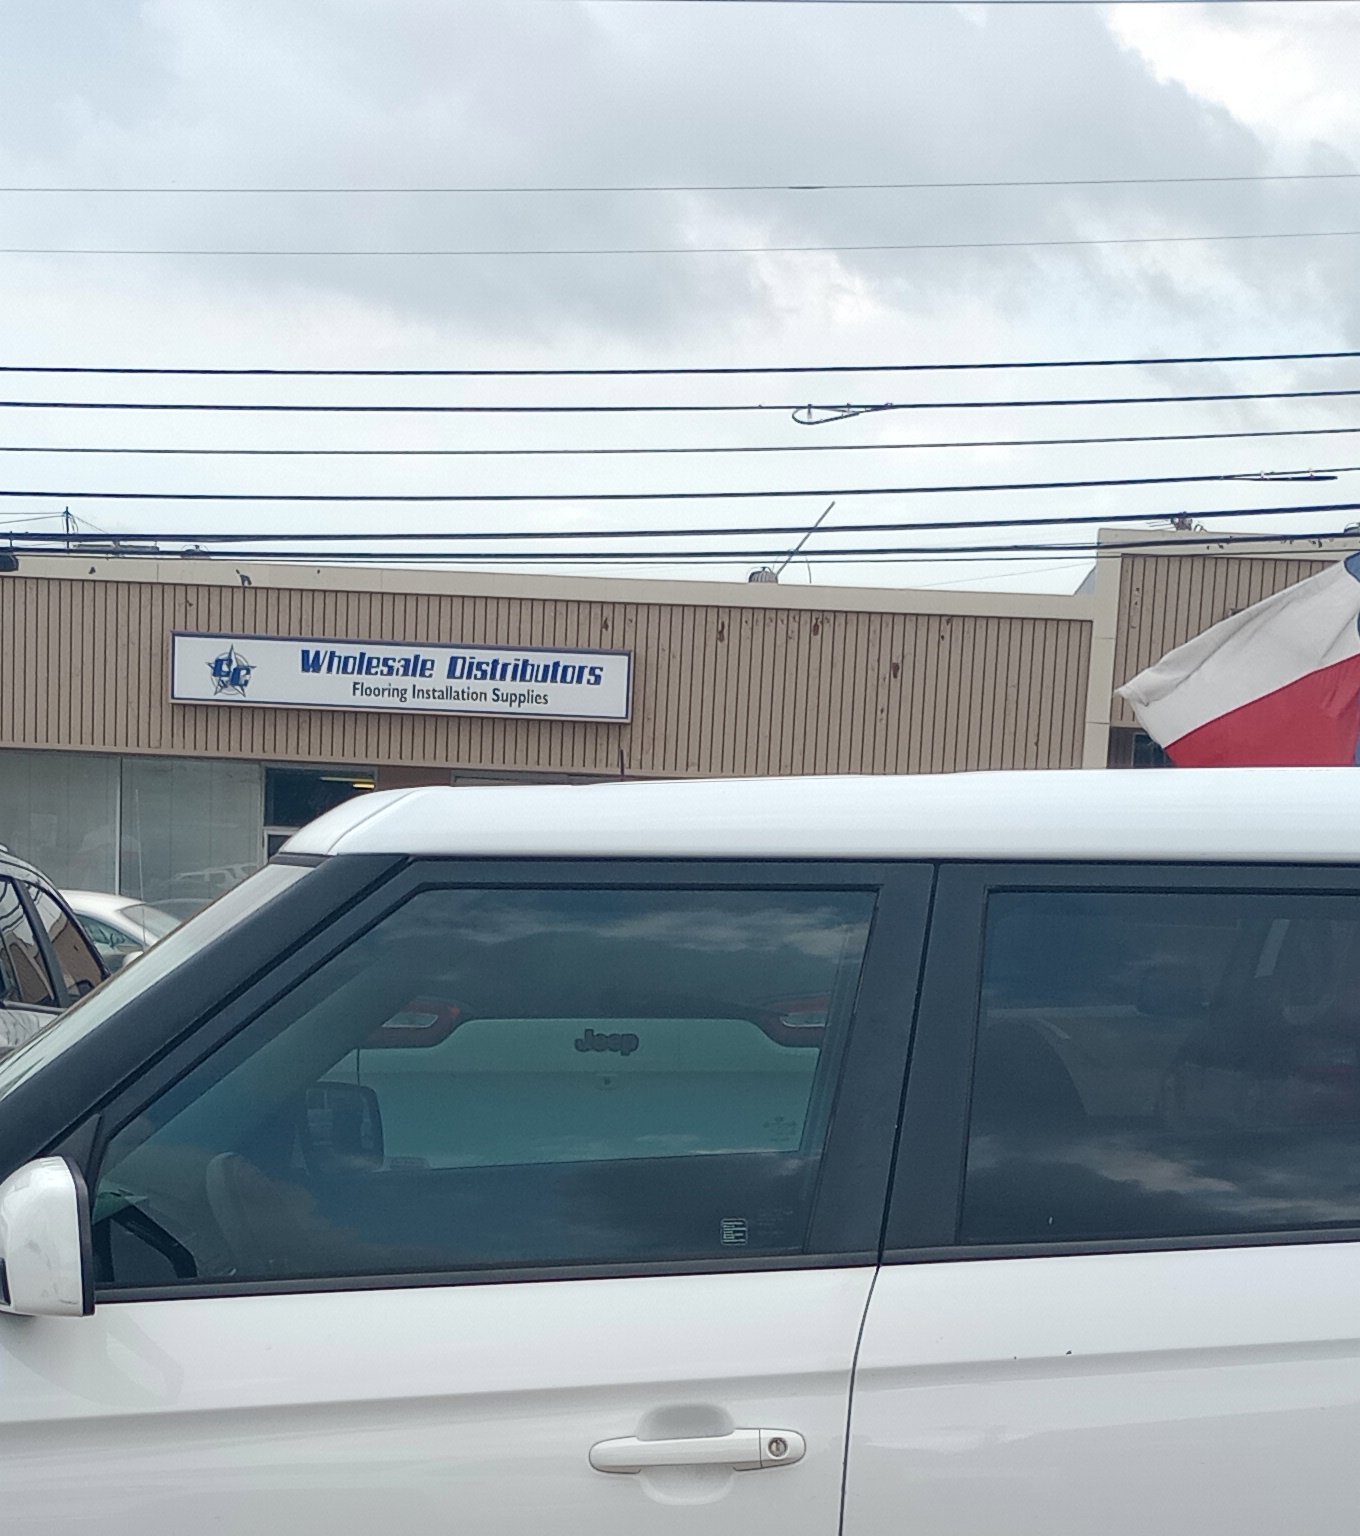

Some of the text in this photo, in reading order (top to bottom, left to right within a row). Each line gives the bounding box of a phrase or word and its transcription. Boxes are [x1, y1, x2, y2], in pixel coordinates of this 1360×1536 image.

[301, 649, 604, 686] Wholesale Distributors
[352, 681, 549, 708] Flooring Installation Supplies
